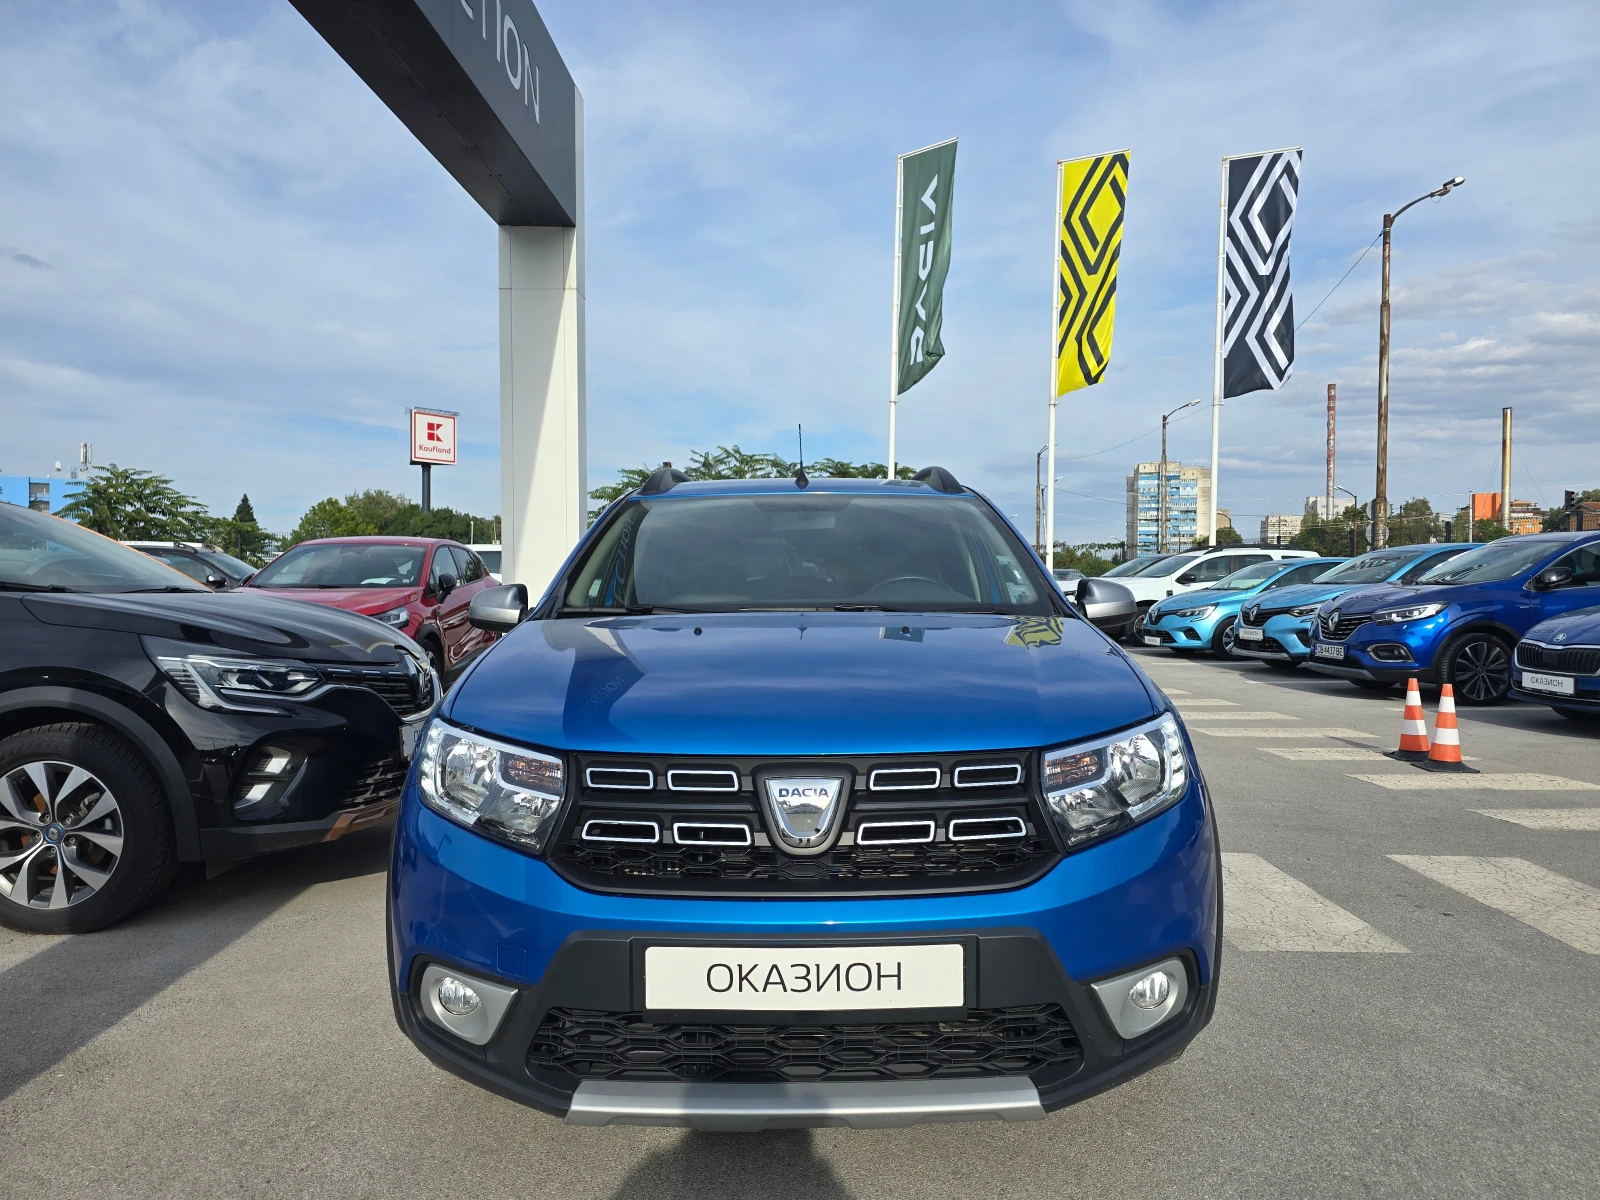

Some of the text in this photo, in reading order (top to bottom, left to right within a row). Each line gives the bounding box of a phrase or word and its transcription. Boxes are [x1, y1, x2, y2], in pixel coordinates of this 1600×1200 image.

[459, 0, 540, 125] ION
[909, 173, 938, 366] DACIA
[418, 444, 451, 454] Kaufland
[1530, 676, 1564, 688] ОКАЗИОН
[778, 787, 829, 798] DACIA
[706, 962, 902, 993] ОКАЗИОН
